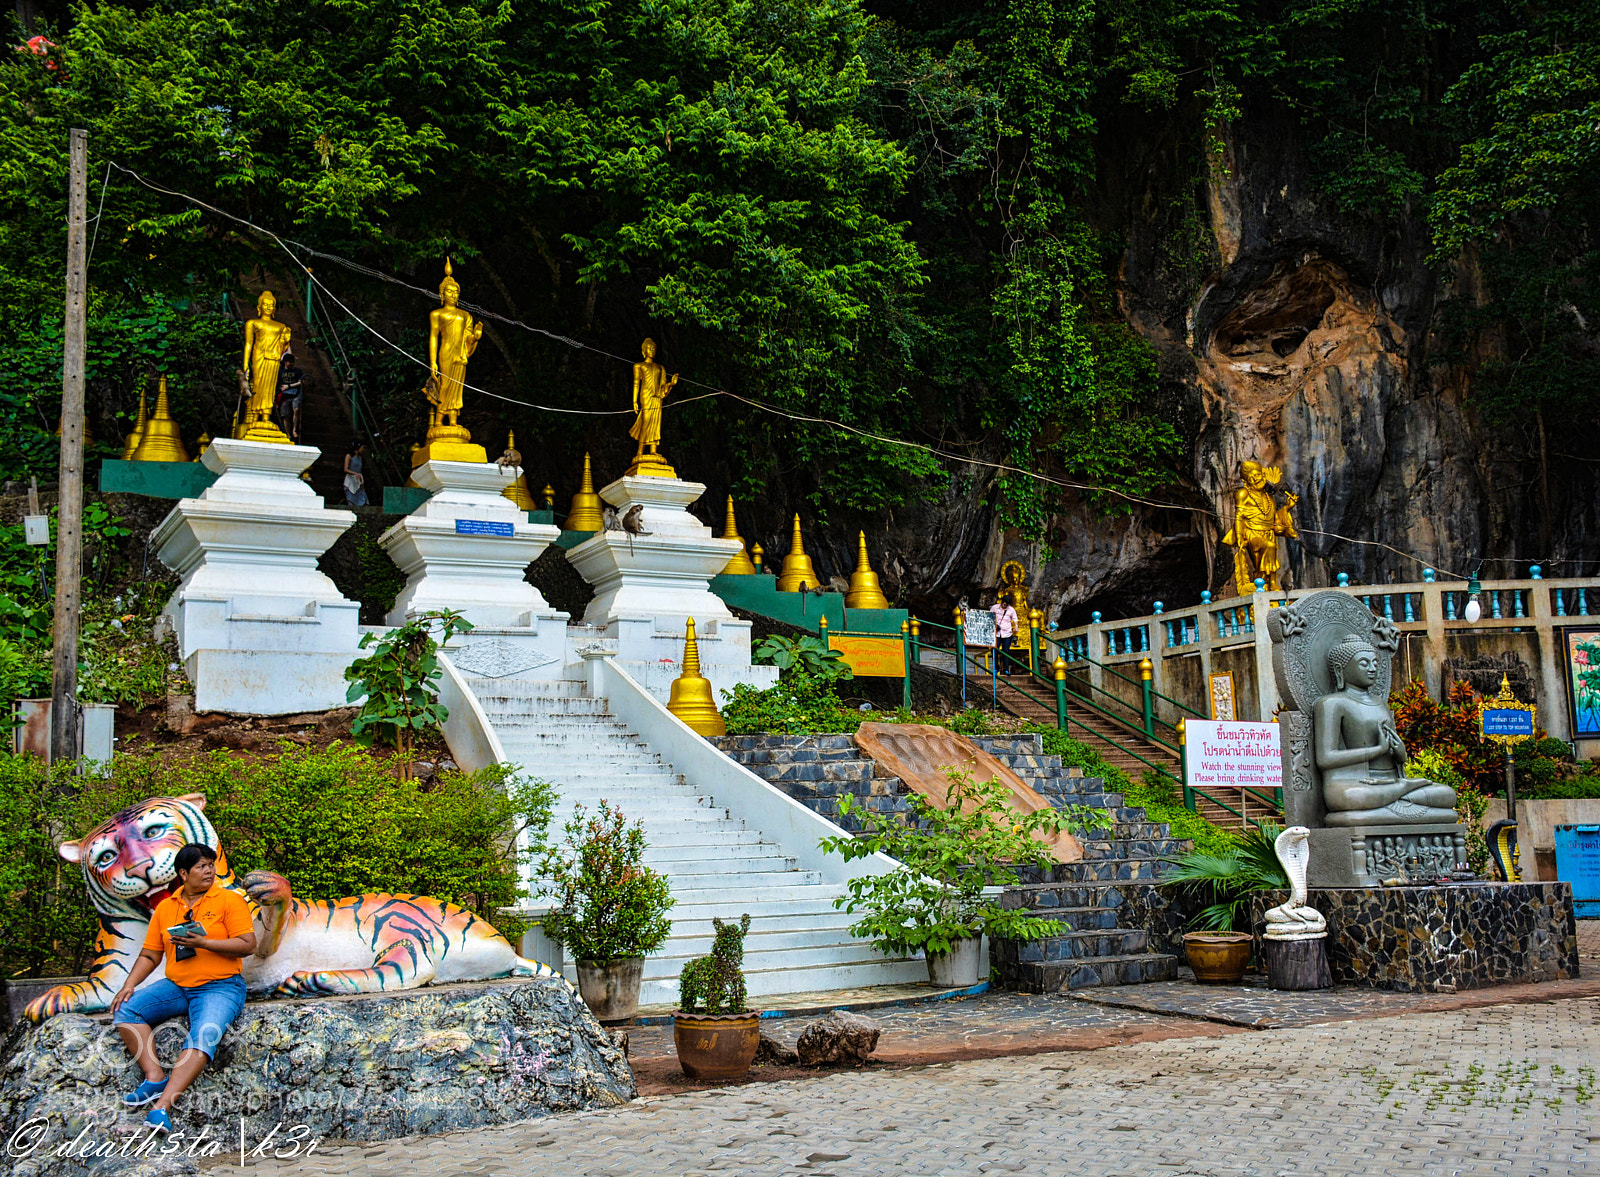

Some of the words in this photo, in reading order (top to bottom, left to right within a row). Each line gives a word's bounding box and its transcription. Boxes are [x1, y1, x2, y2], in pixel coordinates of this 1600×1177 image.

[1201, 761, 1222, 771] Watch
[1224, 761, 1235, 771] the
[1237, 762, 1265, 773] stunning
[1194, 773, 1215, 782] Please
[1217, 773, 1235, 784] bring
[1237, 773, 1265, 784] drinking
